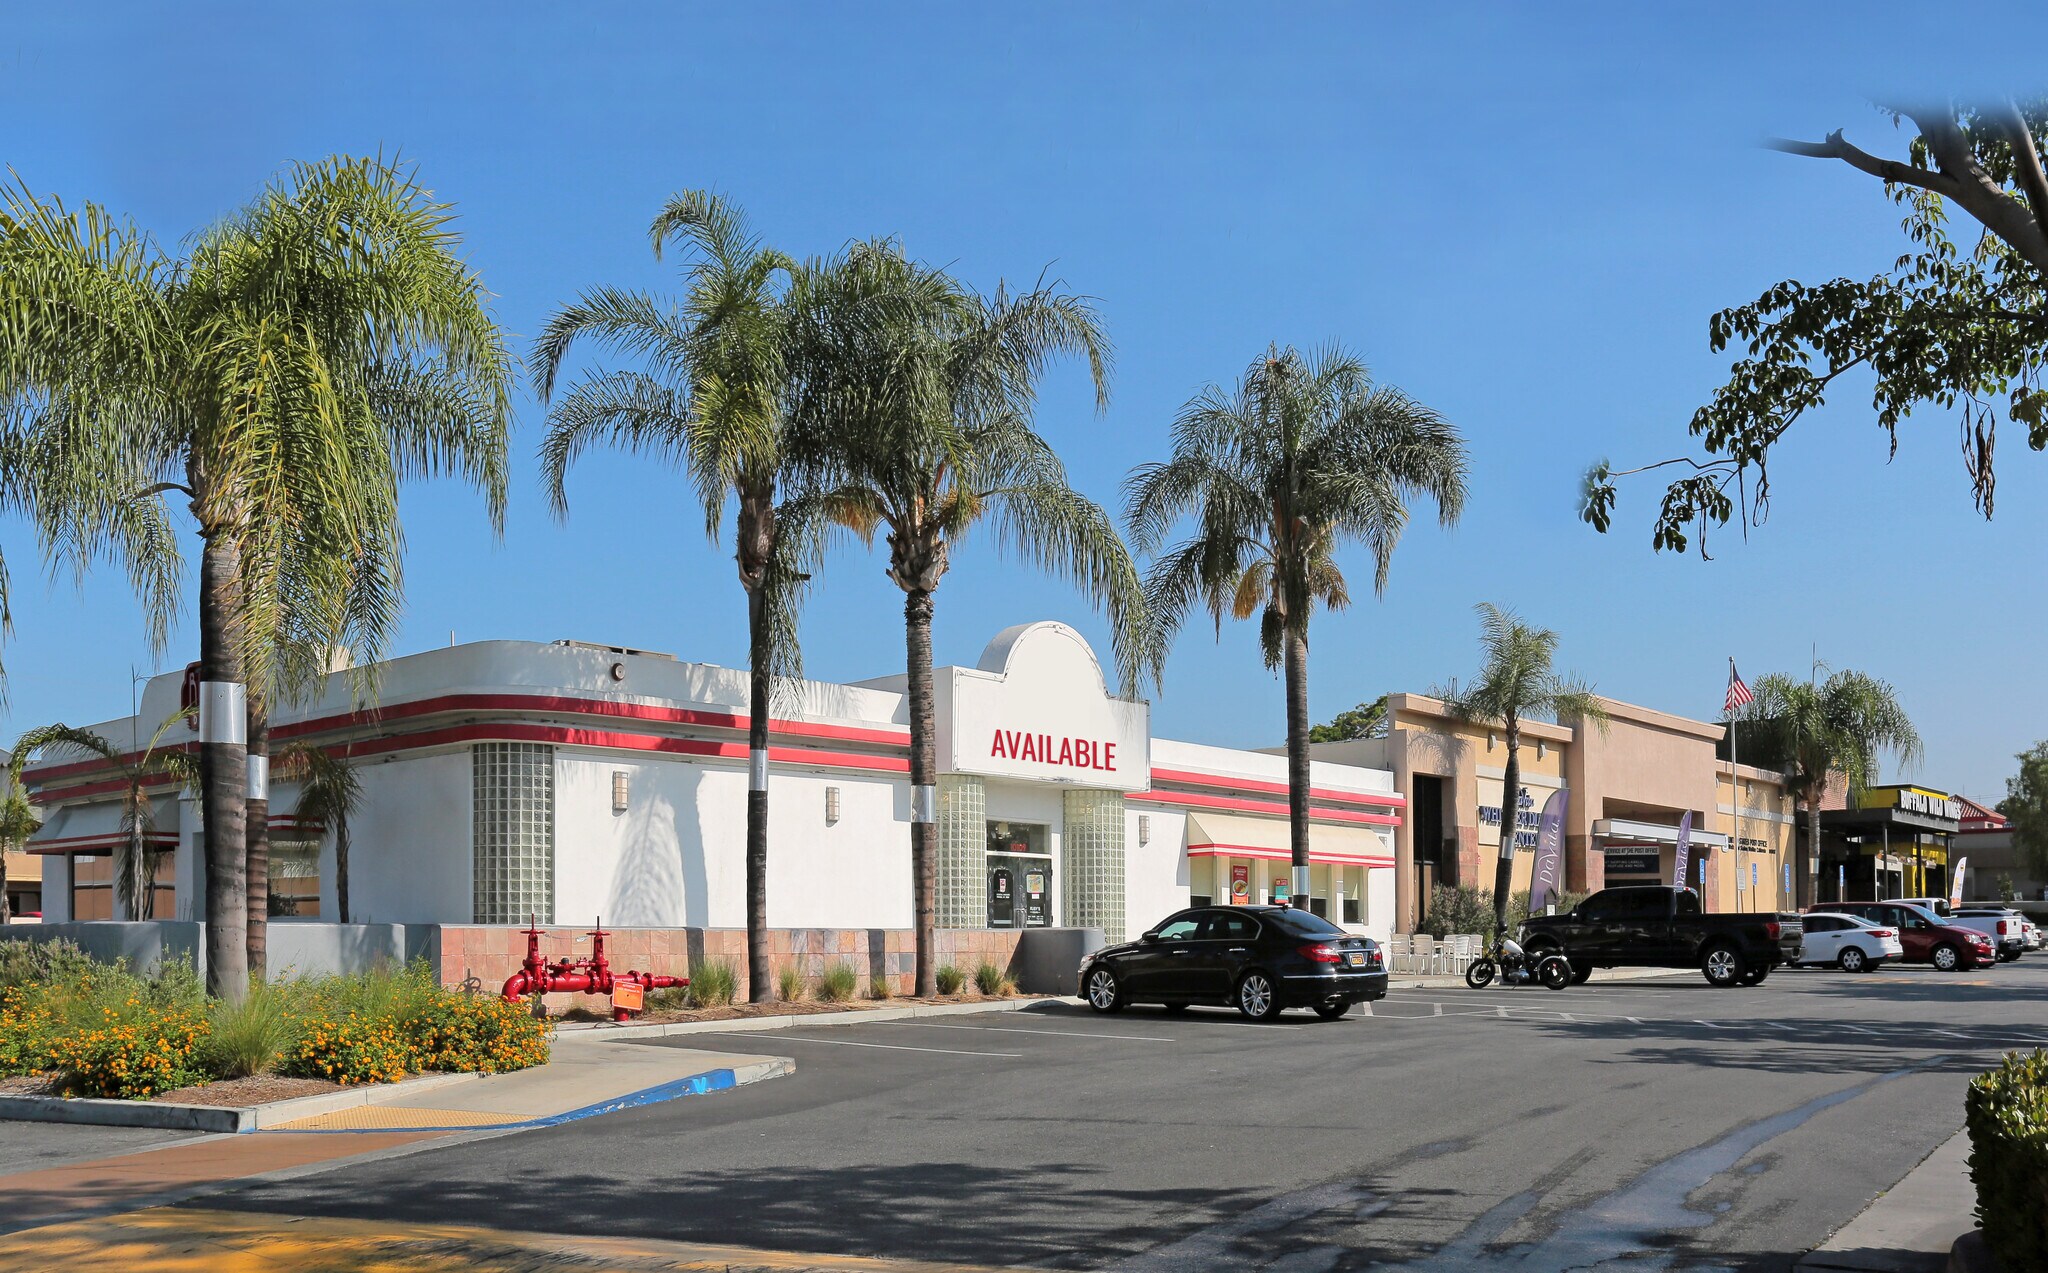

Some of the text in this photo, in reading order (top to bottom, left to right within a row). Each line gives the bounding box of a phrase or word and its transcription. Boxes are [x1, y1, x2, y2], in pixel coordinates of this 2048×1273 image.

[991, 729, 1116, 771] AVAILABLE
[1900, 789, 1927, 813] BUFFALO
[1928, 796, 1943, 816] WILD
